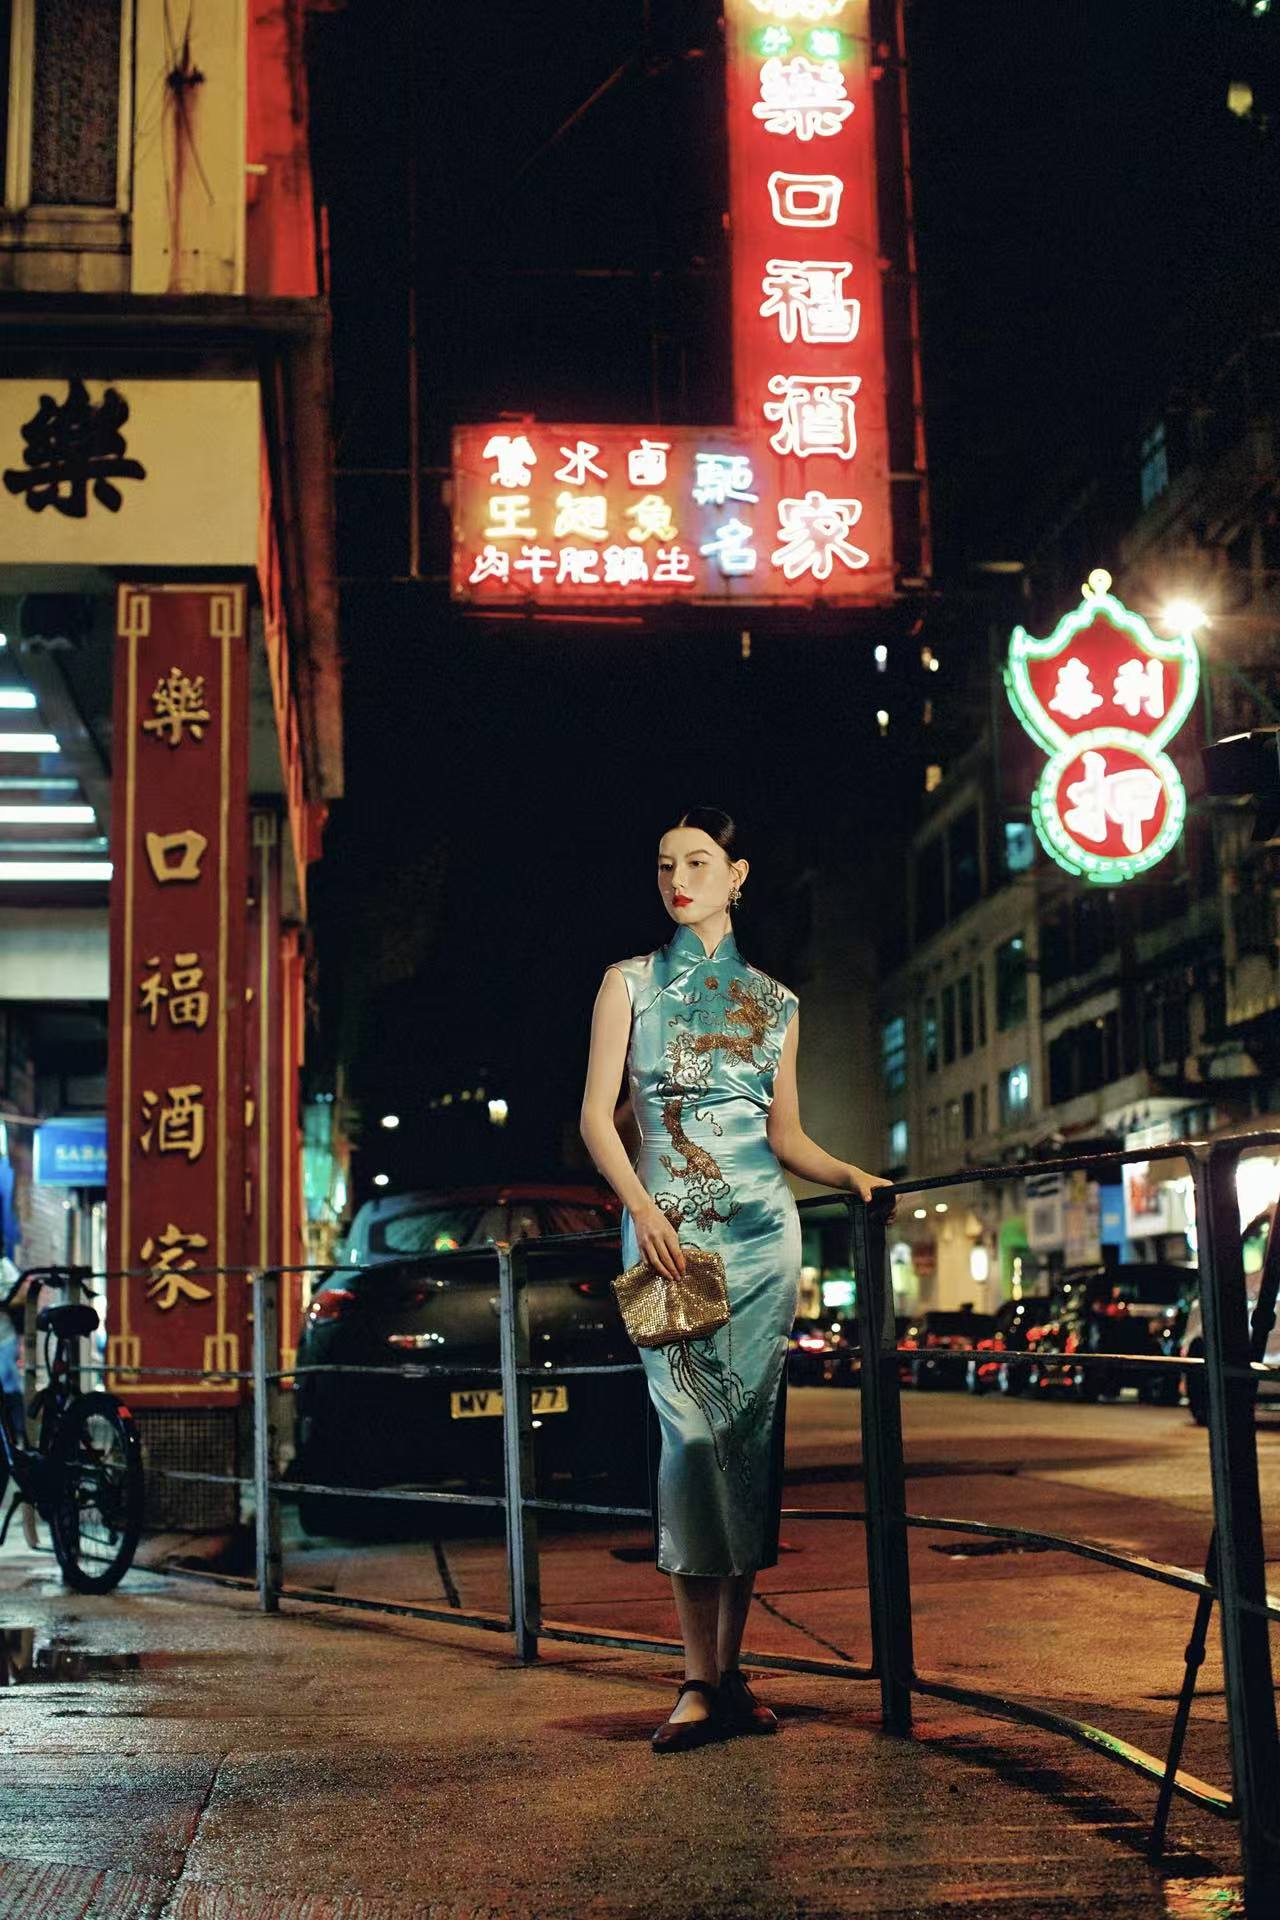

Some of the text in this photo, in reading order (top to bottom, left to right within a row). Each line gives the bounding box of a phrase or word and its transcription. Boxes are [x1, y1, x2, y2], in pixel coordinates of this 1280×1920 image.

[3, 377, 146, 518] 樂
[752, 57, 870, 579] 樂口福酒家
[1063, 751, 1163, 853] 押
[140, 666, 213, 1310] 樂口福酒家
